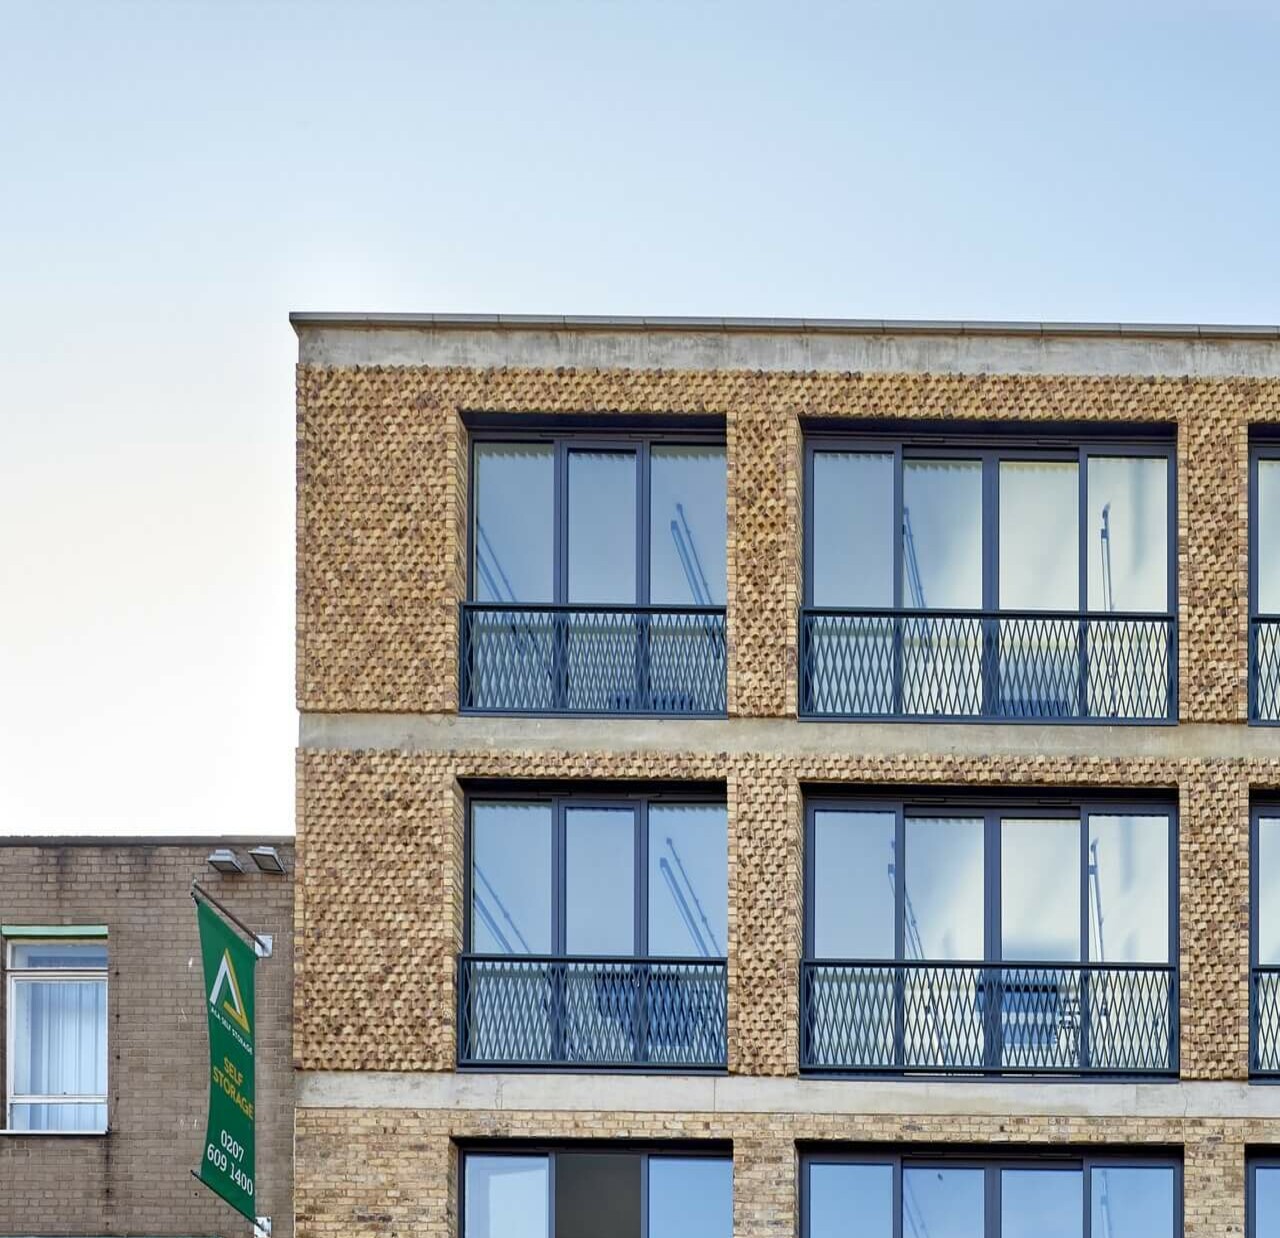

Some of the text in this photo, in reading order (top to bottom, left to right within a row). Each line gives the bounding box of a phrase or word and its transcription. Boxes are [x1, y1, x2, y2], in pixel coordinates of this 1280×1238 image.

[223, 1056, 244, 1086] SELF
[213, 1066, 254, 1120] STORAGE
[220, 1129, 245, 1163] 0207
[207, 1143, 253, 1196] 609 1400
